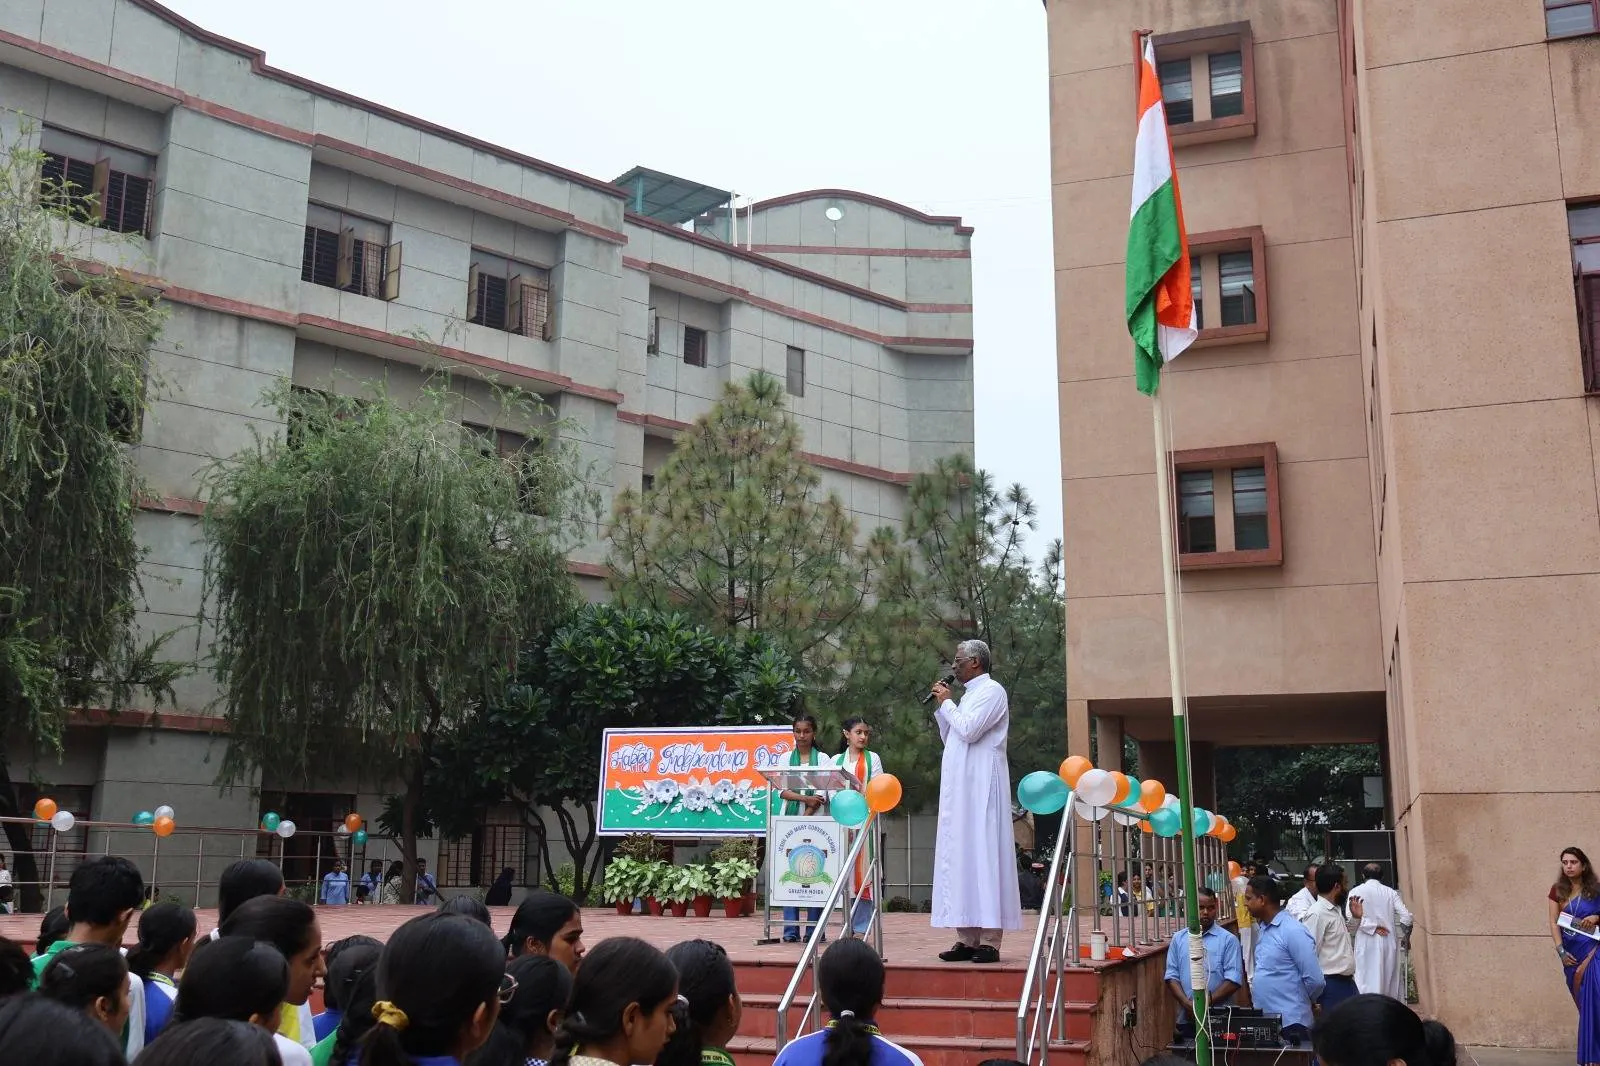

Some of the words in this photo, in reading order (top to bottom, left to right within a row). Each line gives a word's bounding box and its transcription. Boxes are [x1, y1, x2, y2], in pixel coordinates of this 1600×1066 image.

[785, 830, 794, 839] AND
[794, 824, 807, 832] MARY
[808, 824, 828, 836] CONVENT
